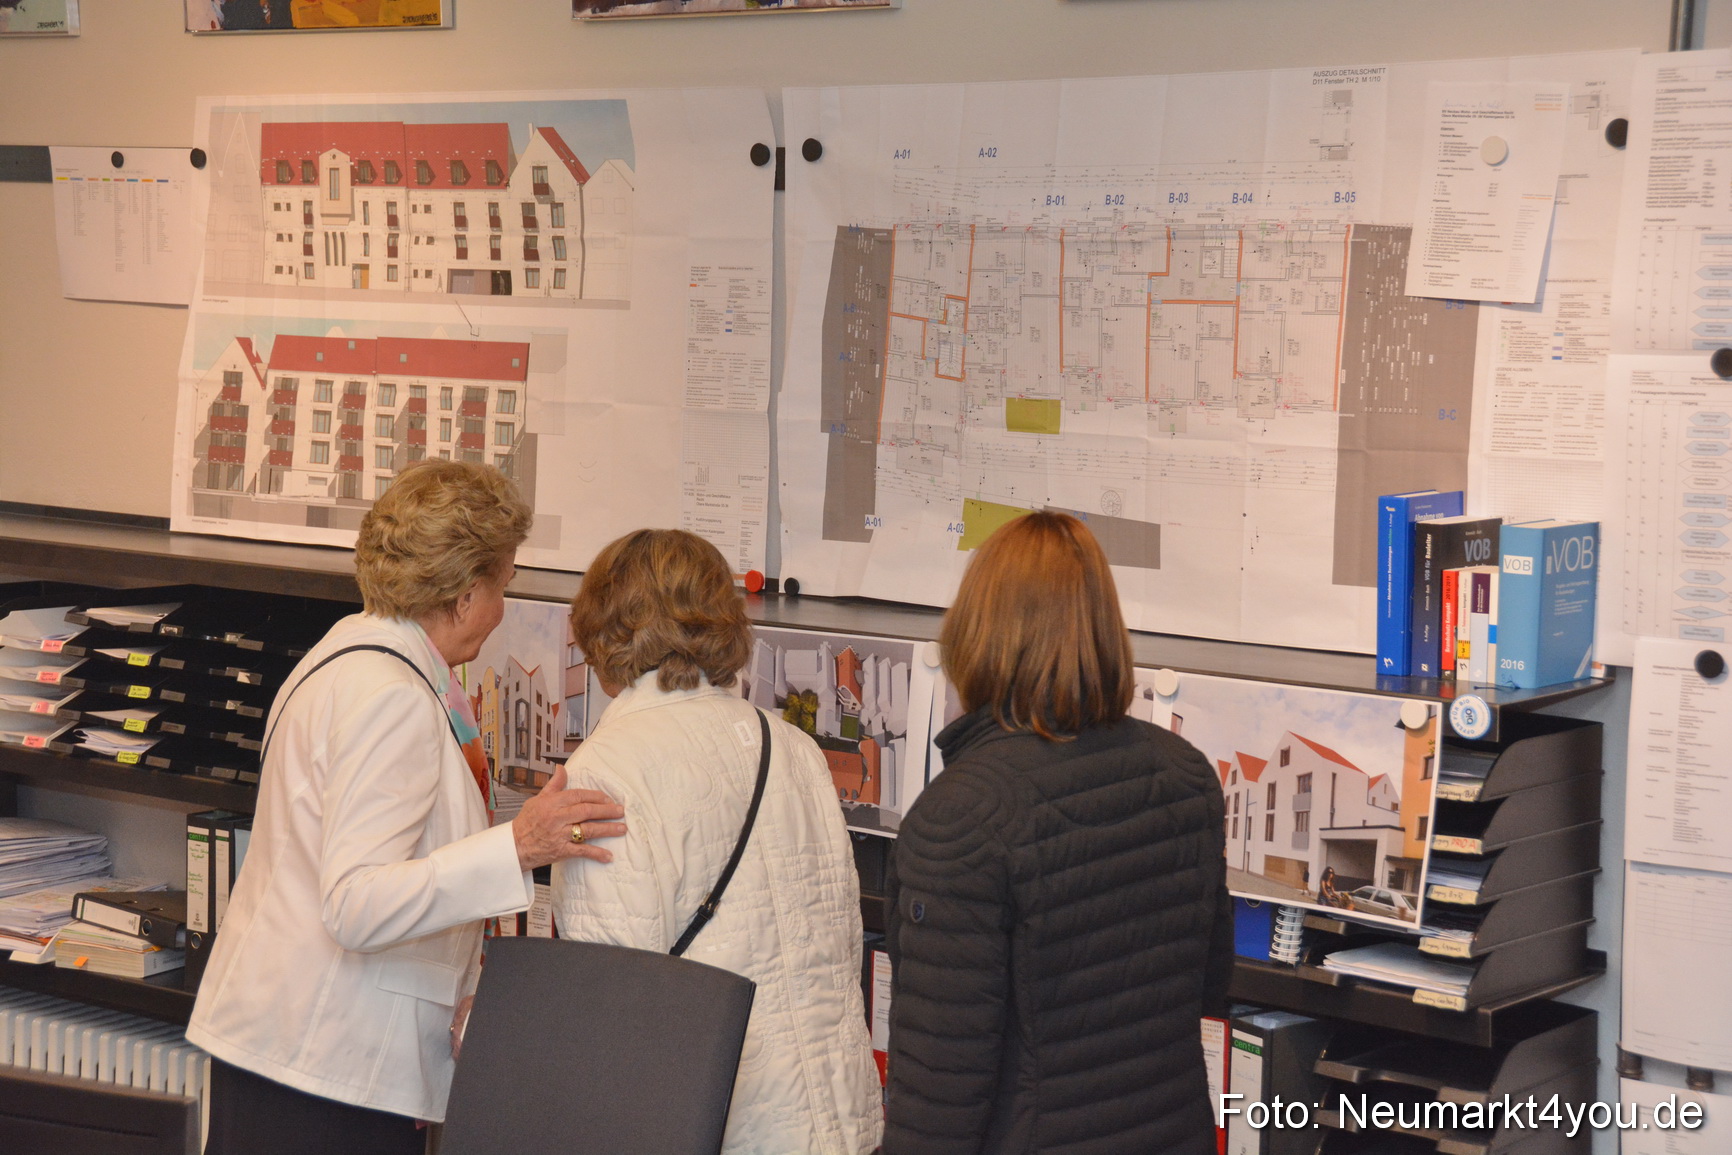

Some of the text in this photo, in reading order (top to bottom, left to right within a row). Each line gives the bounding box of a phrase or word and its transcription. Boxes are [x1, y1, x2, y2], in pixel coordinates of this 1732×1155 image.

[1338, 68, 1386, 76] DETAILSCHNITT
[894, 149, 911, 159] A-01
[978, 147, 997, 158] A-02
[1046, 195, 1065, 206] B-01
[1105, 194, 1124, 205] B-02
[1168, 192, 1189, 204] B-03
[1232, 193, 1253, 204] B-04
[1334, 192, 1356, 203] B-05
[1439, 409, 1456, 420] B-C
[865, 517, 882, 527] A-01
[947, 522, 964, 534] A-02
[1464, 538, 1491, 562] VOB
[1552, 536, 1594, 573] VOB
[1504, 558, 1531, 572] VOB
[1500, 658, 1525, 671] 2016
[189, 833, 208, 842] centra
[1469, 839, 1476, 849] A
[1234, 1039, 1261, 1054] centra
